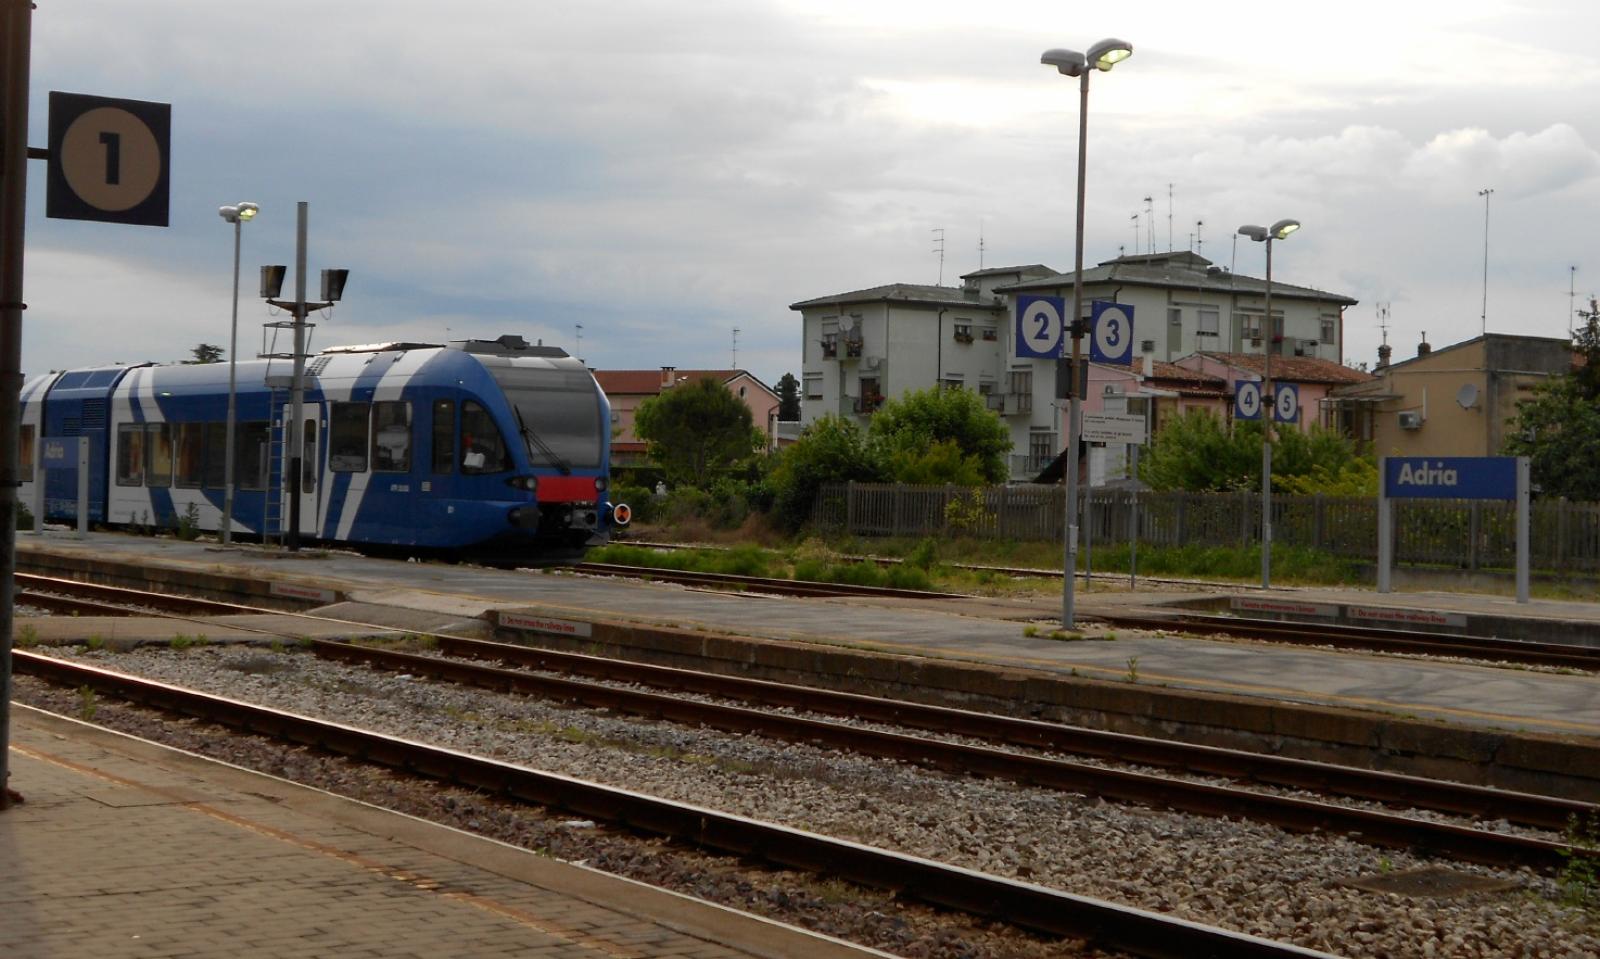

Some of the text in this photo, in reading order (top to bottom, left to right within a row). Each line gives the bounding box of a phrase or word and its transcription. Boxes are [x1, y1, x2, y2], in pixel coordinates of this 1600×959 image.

[99, 131, 120, 185] 1
[1034, 311, 1049, 340] 2
[1105, 319, 1120, 347] 3
[1244, 391, 1253, 408] 4
[1283, 395, 1291, 412] 5
[1398, 461, 1457, 486] Adria
